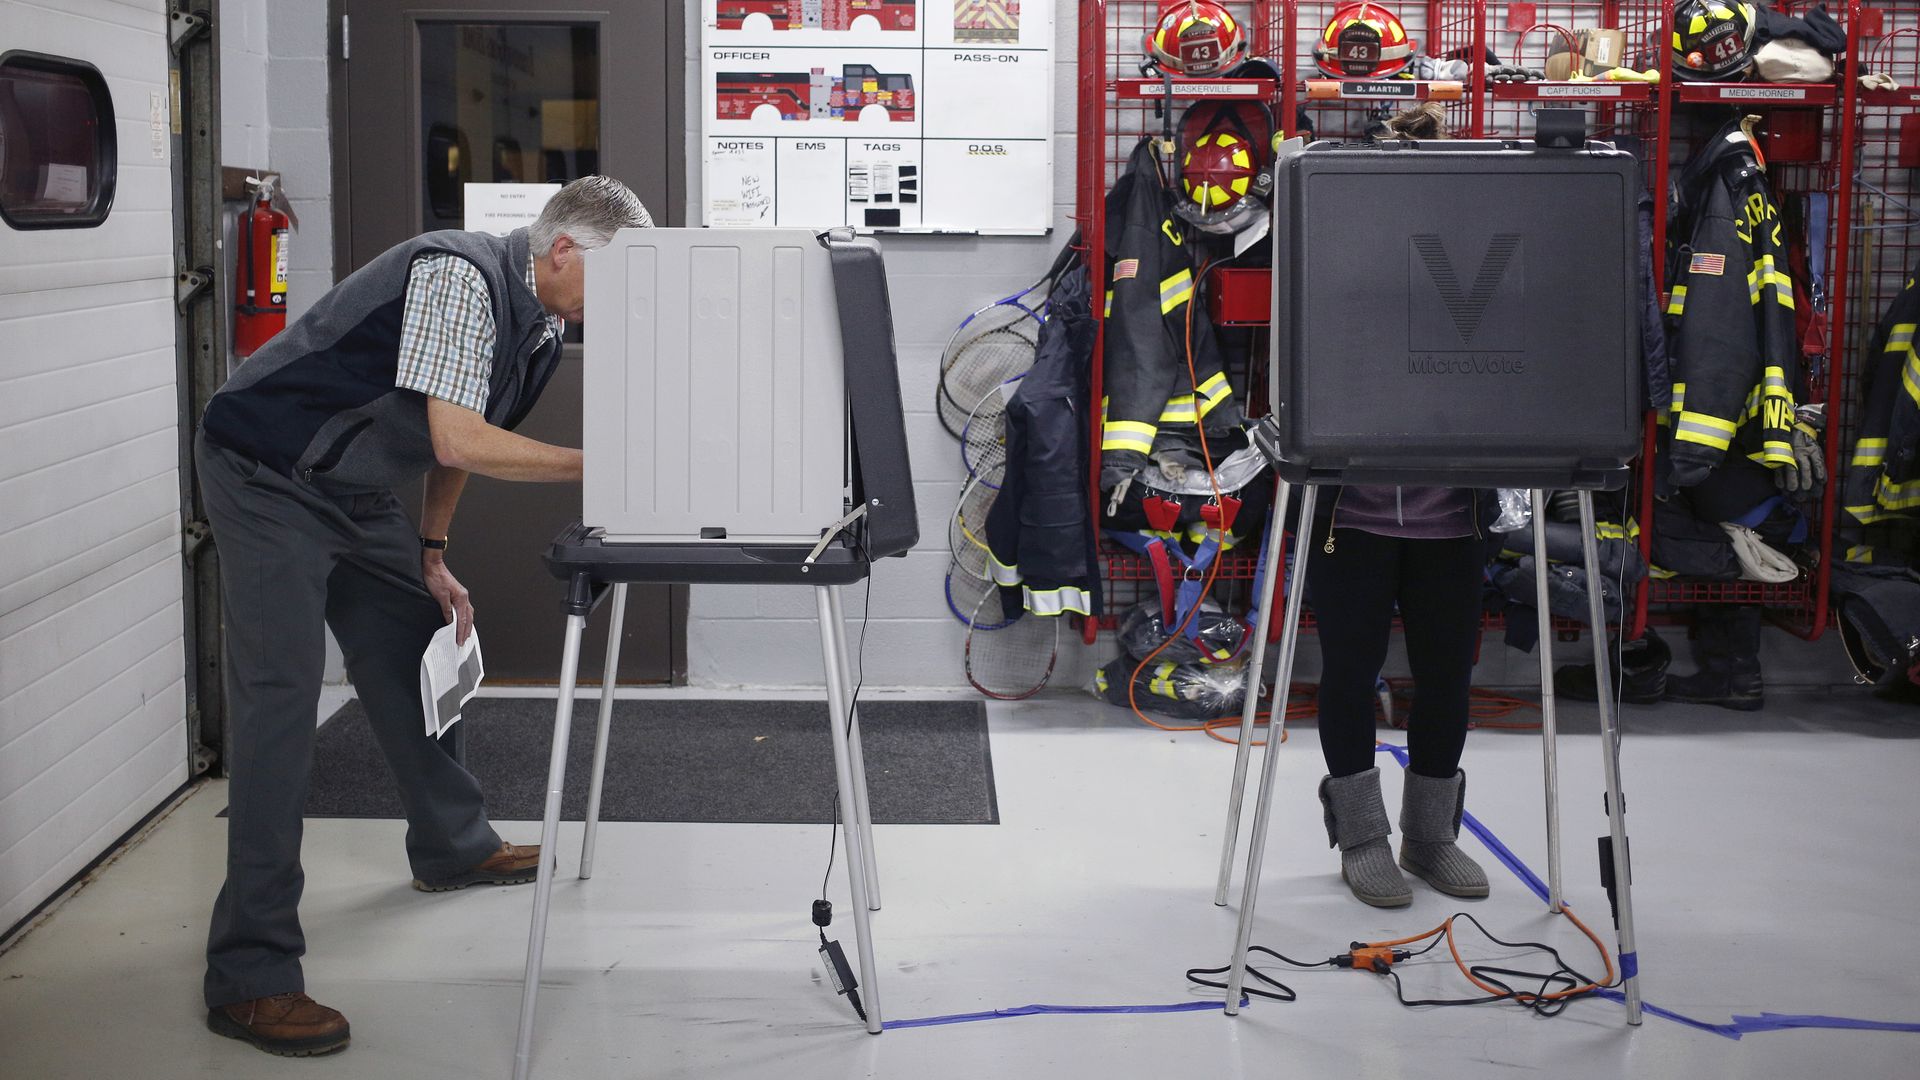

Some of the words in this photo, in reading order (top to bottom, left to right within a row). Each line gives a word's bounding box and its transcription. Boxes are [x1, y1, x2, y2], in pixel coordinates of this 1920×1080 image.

[1192, 46, 1210, 60] 43
[1349, 45, 1368, 59] 43
[1715, 37, 1737, 60] 43
[713, 52, 770, 60] OFFICER
[954, 54, 1019, 63] PASS-ON
[1148, 85, 1166, 93] CAP
[1174, 85, 1232, 93] BASKERVILLE
[1356, 85, 1365, 93] D.
[1369, 85, 1401, 93] MARTIN
[1547, 87, 1569, 95] CAPT
[1572, 87, 1601, 95] FUCHS
[1728, 89, 1756, 97] MEDIC
[1758, 90, 1795, 98] HORNER
[717, 142, 764, 150] NOTES
[796, 142, 826, 151] EMS
[864, 143, 901, 152] TAGS
[1407, 356, 1525, 375] MicroVote
